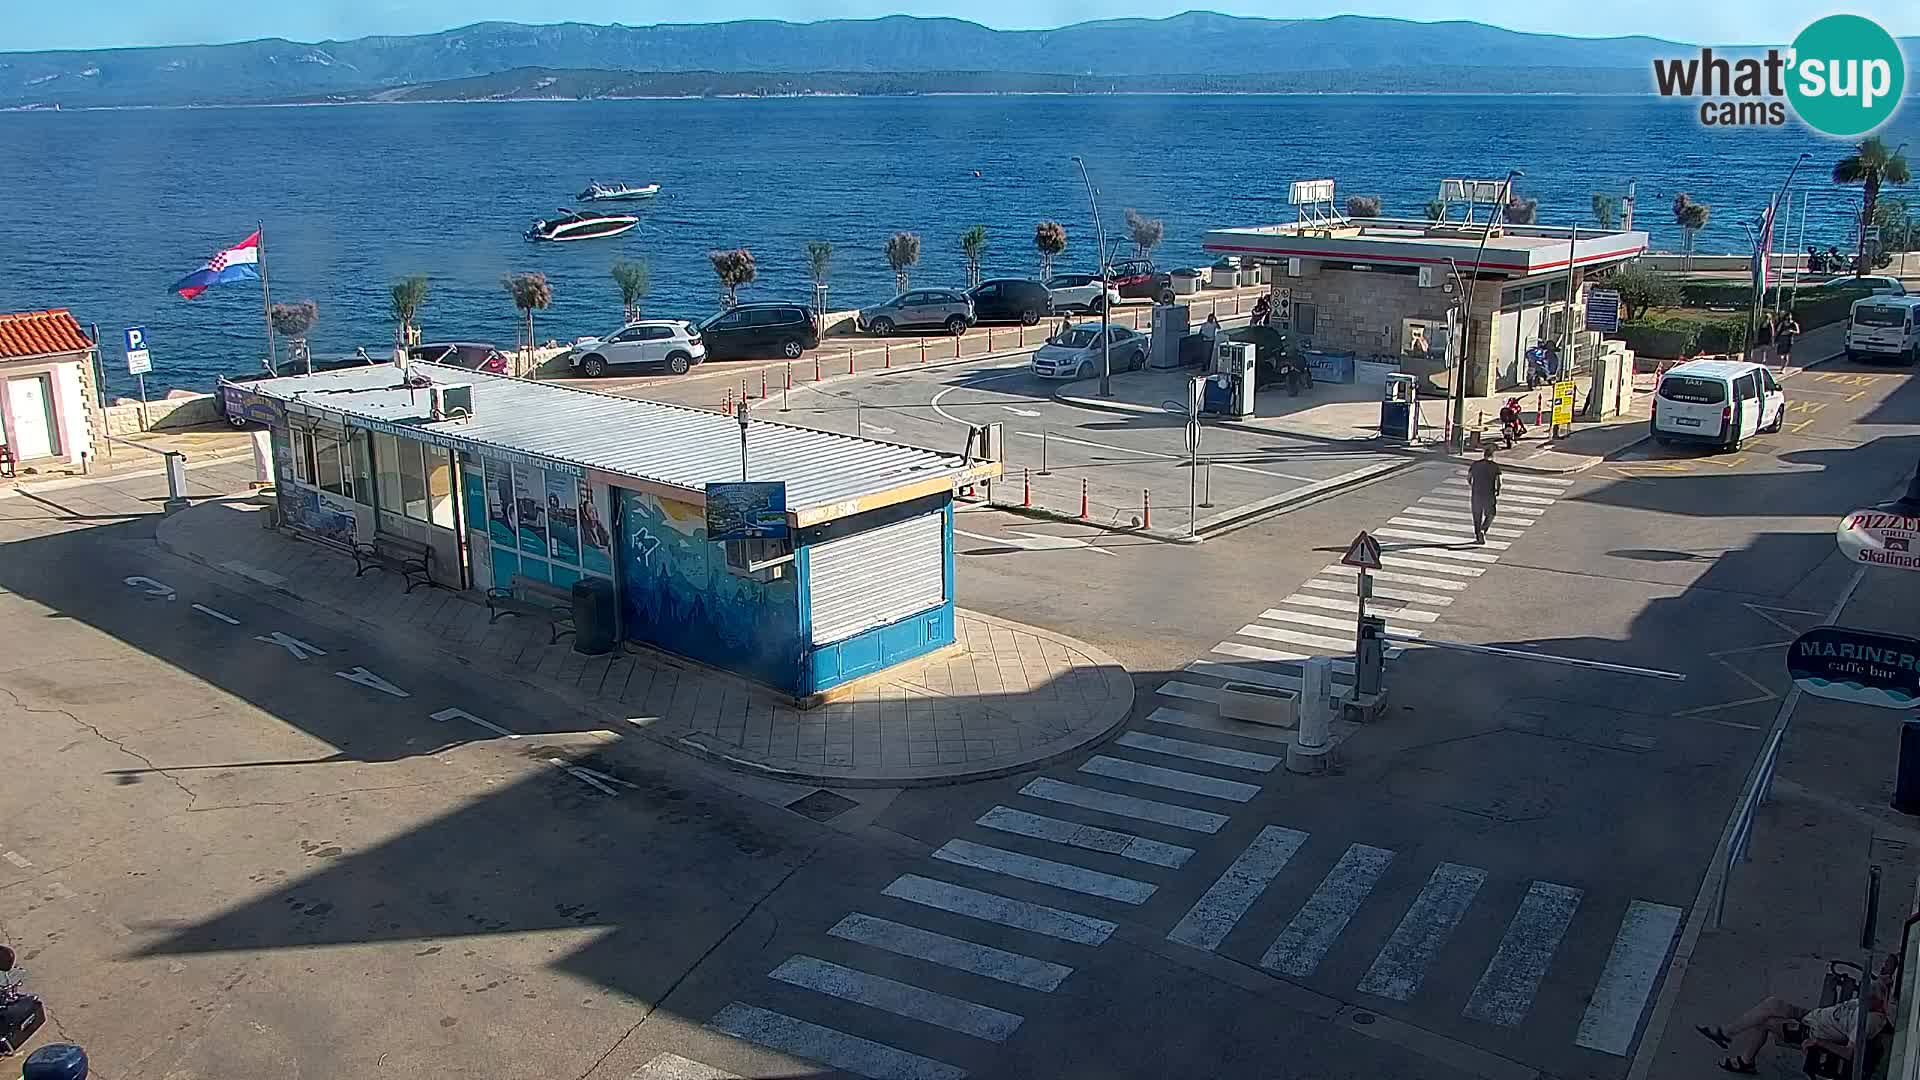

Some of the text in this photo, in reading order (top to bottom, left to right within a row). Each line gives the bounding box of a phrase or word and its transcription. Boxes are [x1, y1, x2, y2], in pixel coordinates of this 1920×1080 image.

[128, 330, 142, 349] P
[1814, 372, 1880, 386] TAXI
[493, 449, 526, 464] STATION
[528, 456, 553, 471] TICKET
[555, 462, 581, 476] OFFICE
[1881, 529, 1917, 539] GRILL
[1828, 661, 1896, 679] caffe bar
